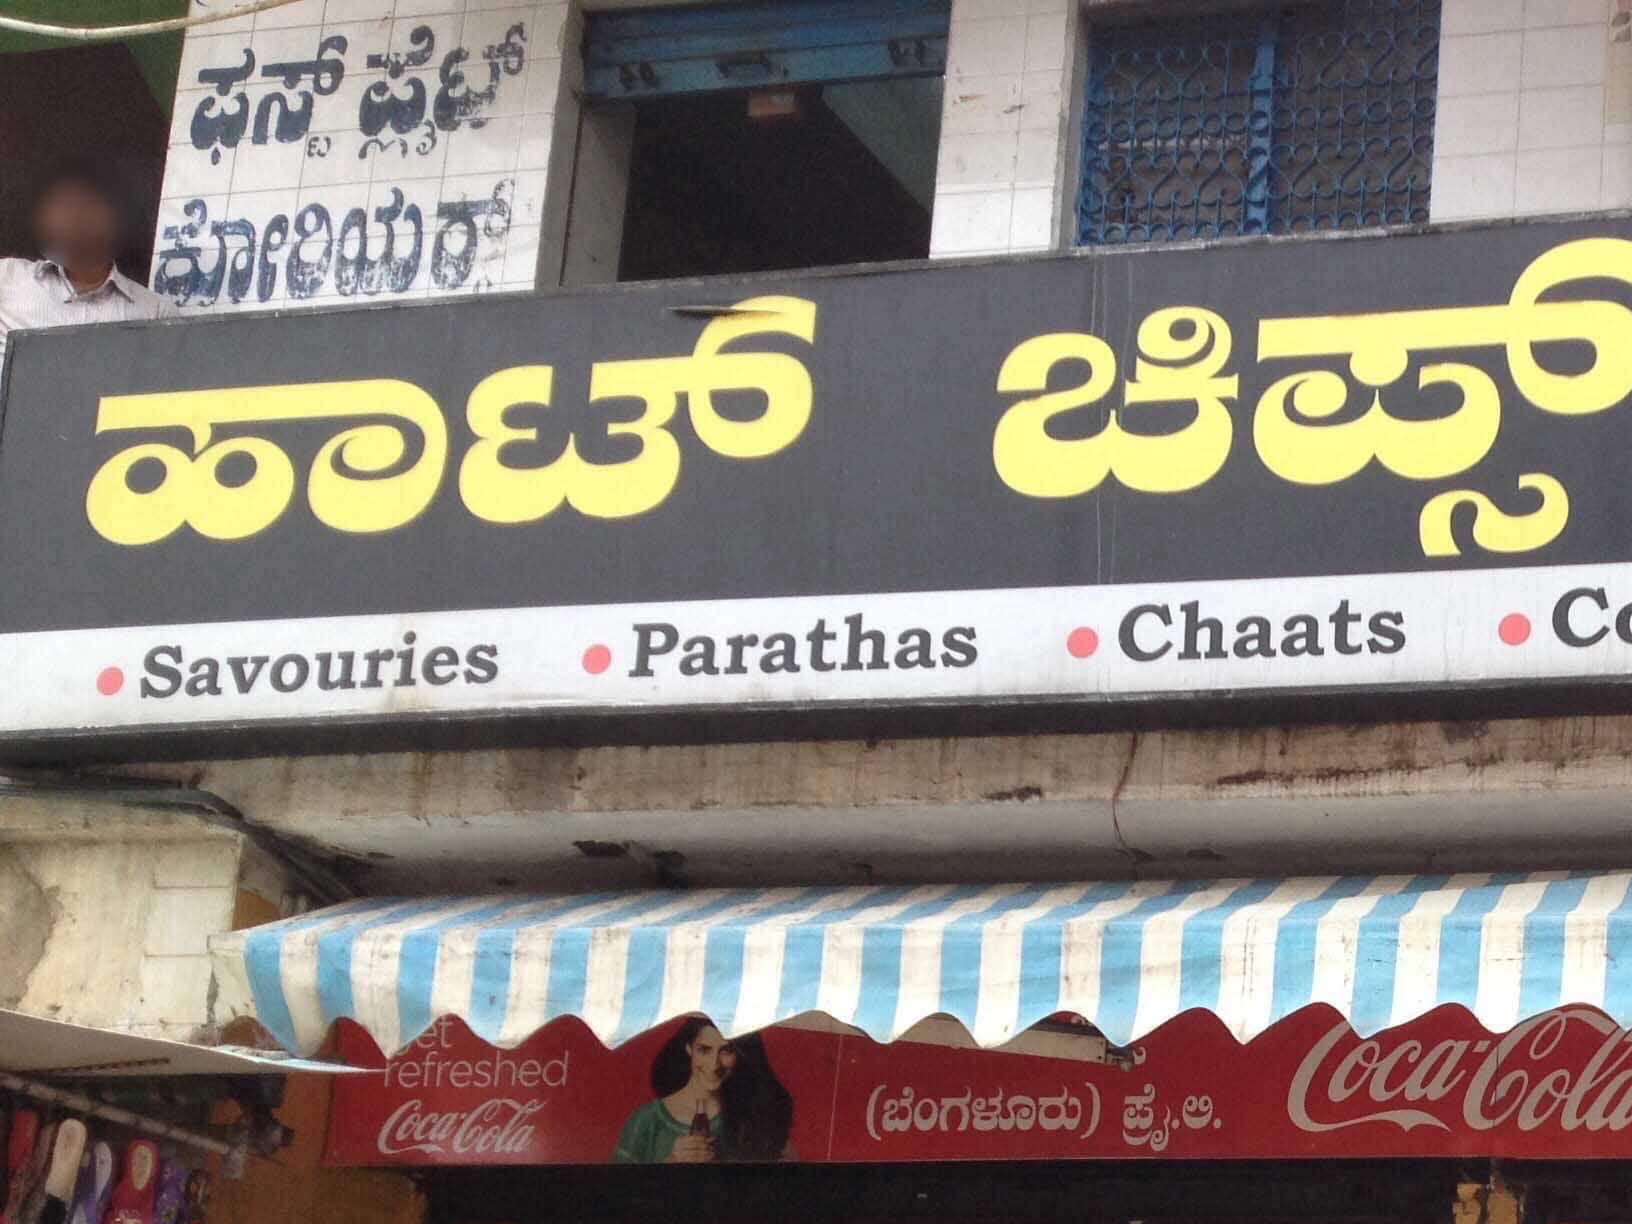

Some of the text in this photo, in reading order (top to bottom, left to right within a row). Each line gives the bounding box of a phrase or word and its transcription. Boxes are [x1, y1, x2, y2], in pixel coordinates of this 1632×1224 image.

[86, 295, 817, 546] ಹಾಟ್
[628, 613, 978, 679] Parathas
[1118, 599, 1406, 662] Chaats
[139, 631, 499, 700] Savouries
[384, 1050, 569, 1088] refreshed
[377, 1098, 549, 1155] Coca-Cola
[866, 1082, 1101, 1142] (ಬೆಂಗಳೂರು)
